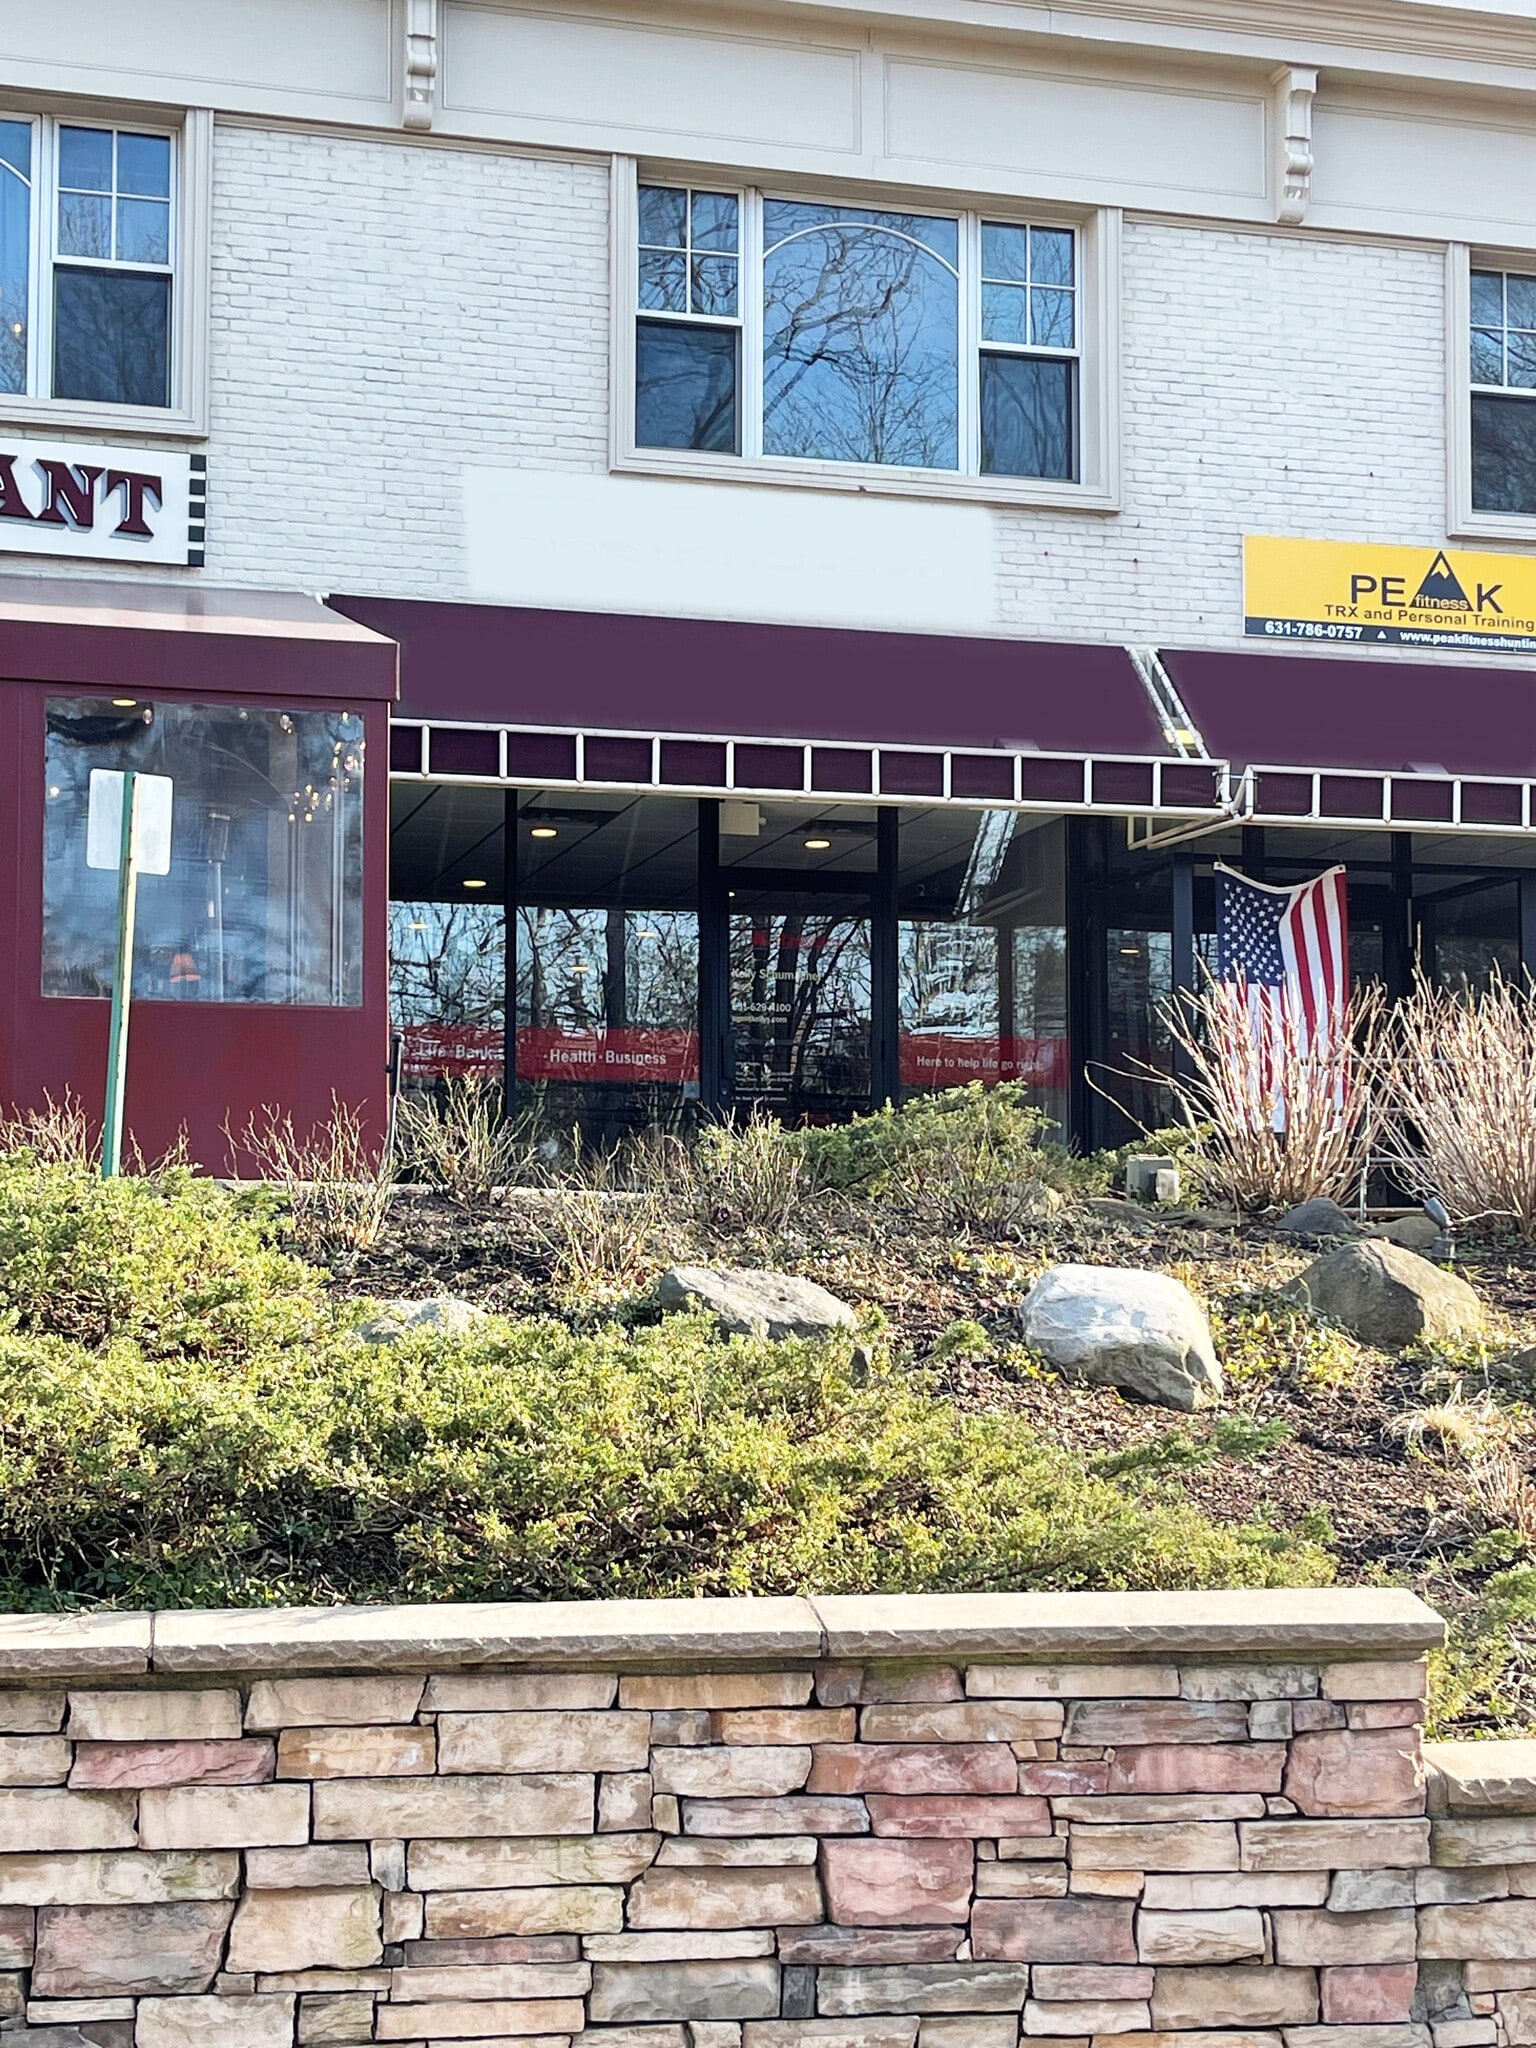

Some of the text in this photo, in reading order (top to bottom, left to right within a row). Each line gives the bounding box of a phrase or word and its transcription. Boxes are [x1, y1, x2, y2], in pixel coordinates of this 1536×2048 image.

[1415, 593, 1469, 611] fitness
[1324, 604, 1535, 632] TRX and Personal Training
[1264, 620, 1363, 640] 631-786-0757
[550, 1048, 667, 1066] Health Business
[917, 1056, 942, 1068] Here
[944, 1057, 955, 1068] to
[958, 1057, 980, 1070] help
[983, 1058, 998, 1069] life
[1001, 1060, 1014, 1071] go
